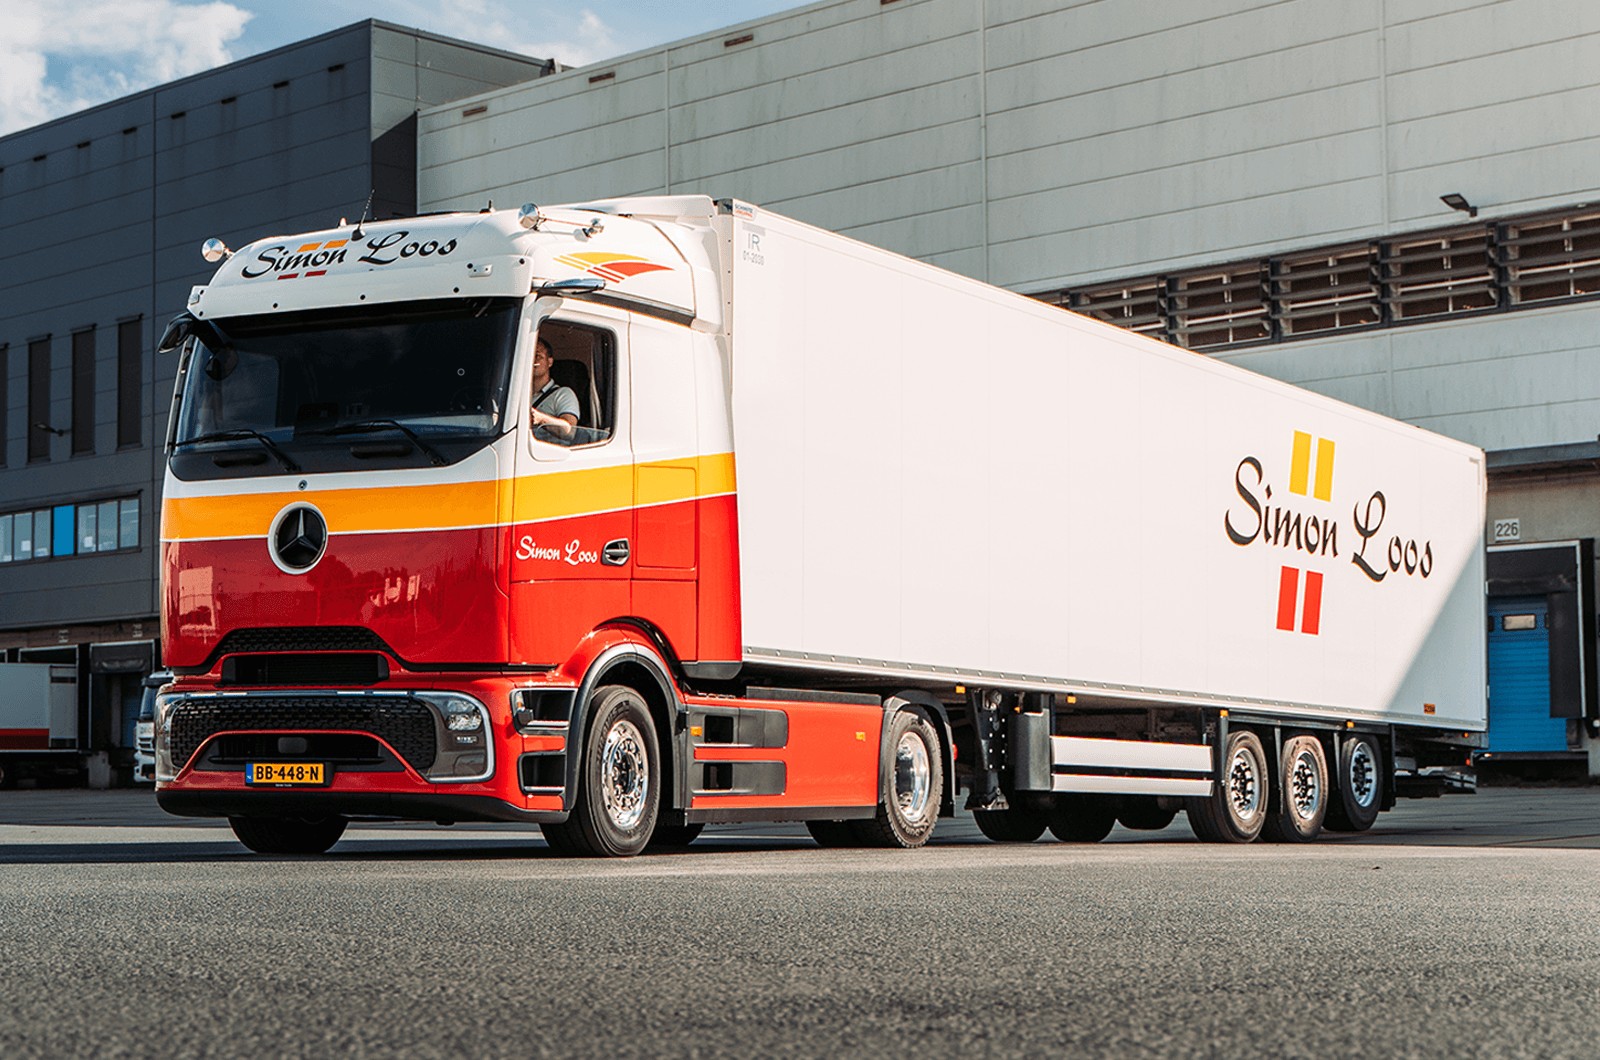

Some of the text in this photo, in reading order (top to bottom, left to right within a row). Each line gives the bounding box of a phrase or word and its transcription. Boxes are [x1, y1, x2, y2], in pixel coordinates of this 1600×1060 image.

[241, 231, 458, 279] Simon Loos
[1224, 455, 1433, 583] Simon Loos
[1495, 522, 1518, 537] 226
[515, 535, 598, 566] Simon Loos
[256, 765, 319, 781] BB-448-N
